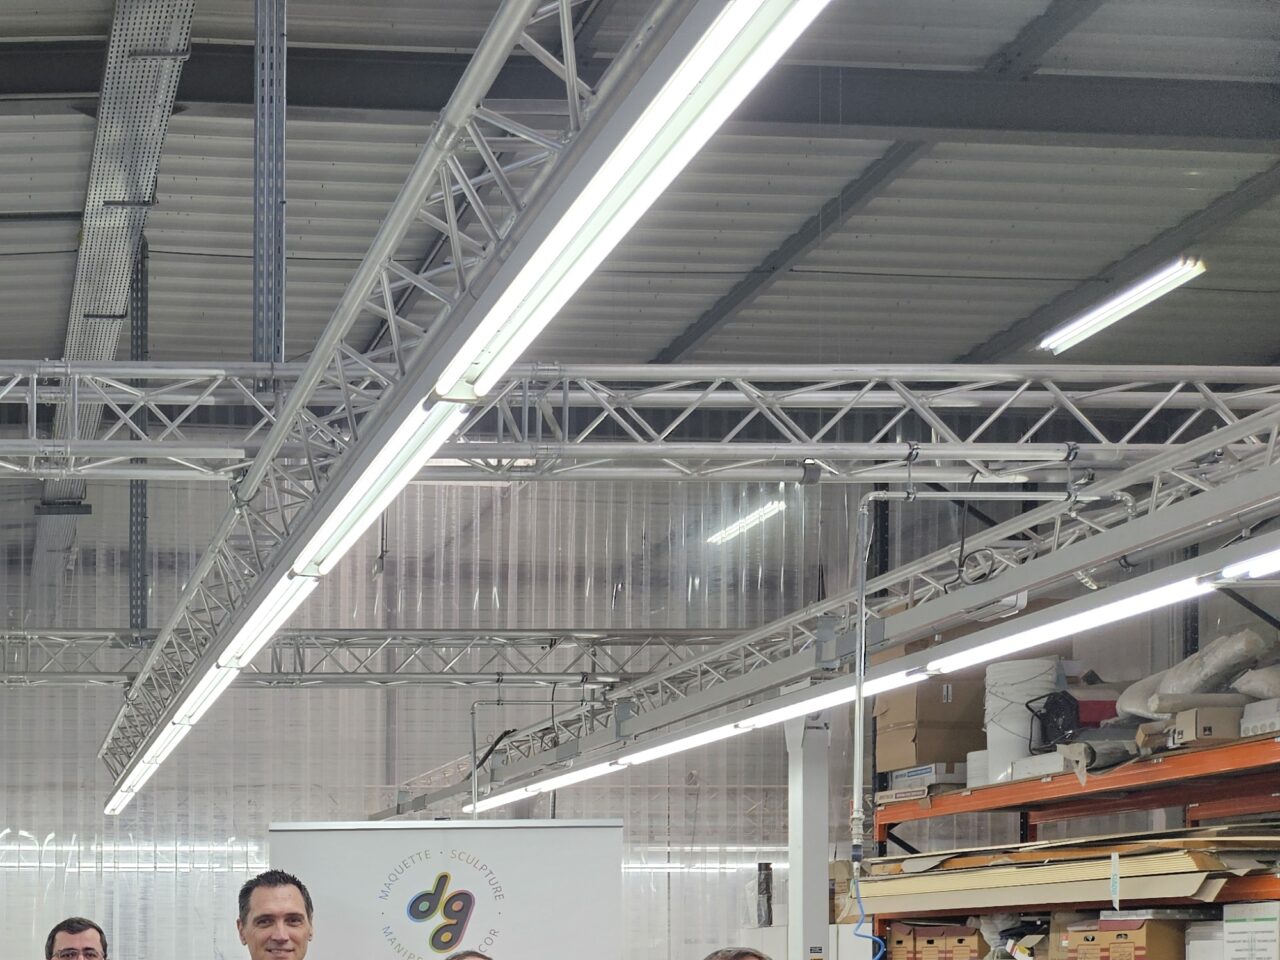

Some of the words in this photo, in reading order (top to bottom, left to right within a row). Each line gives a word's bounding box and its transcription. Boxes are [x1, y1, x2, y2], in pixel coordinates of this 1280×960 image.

[379, 850, 431, 900] MAQUETTE
[450, 849, 505, 900] SCULPTURE
[478, 928, 500, 953] COR
